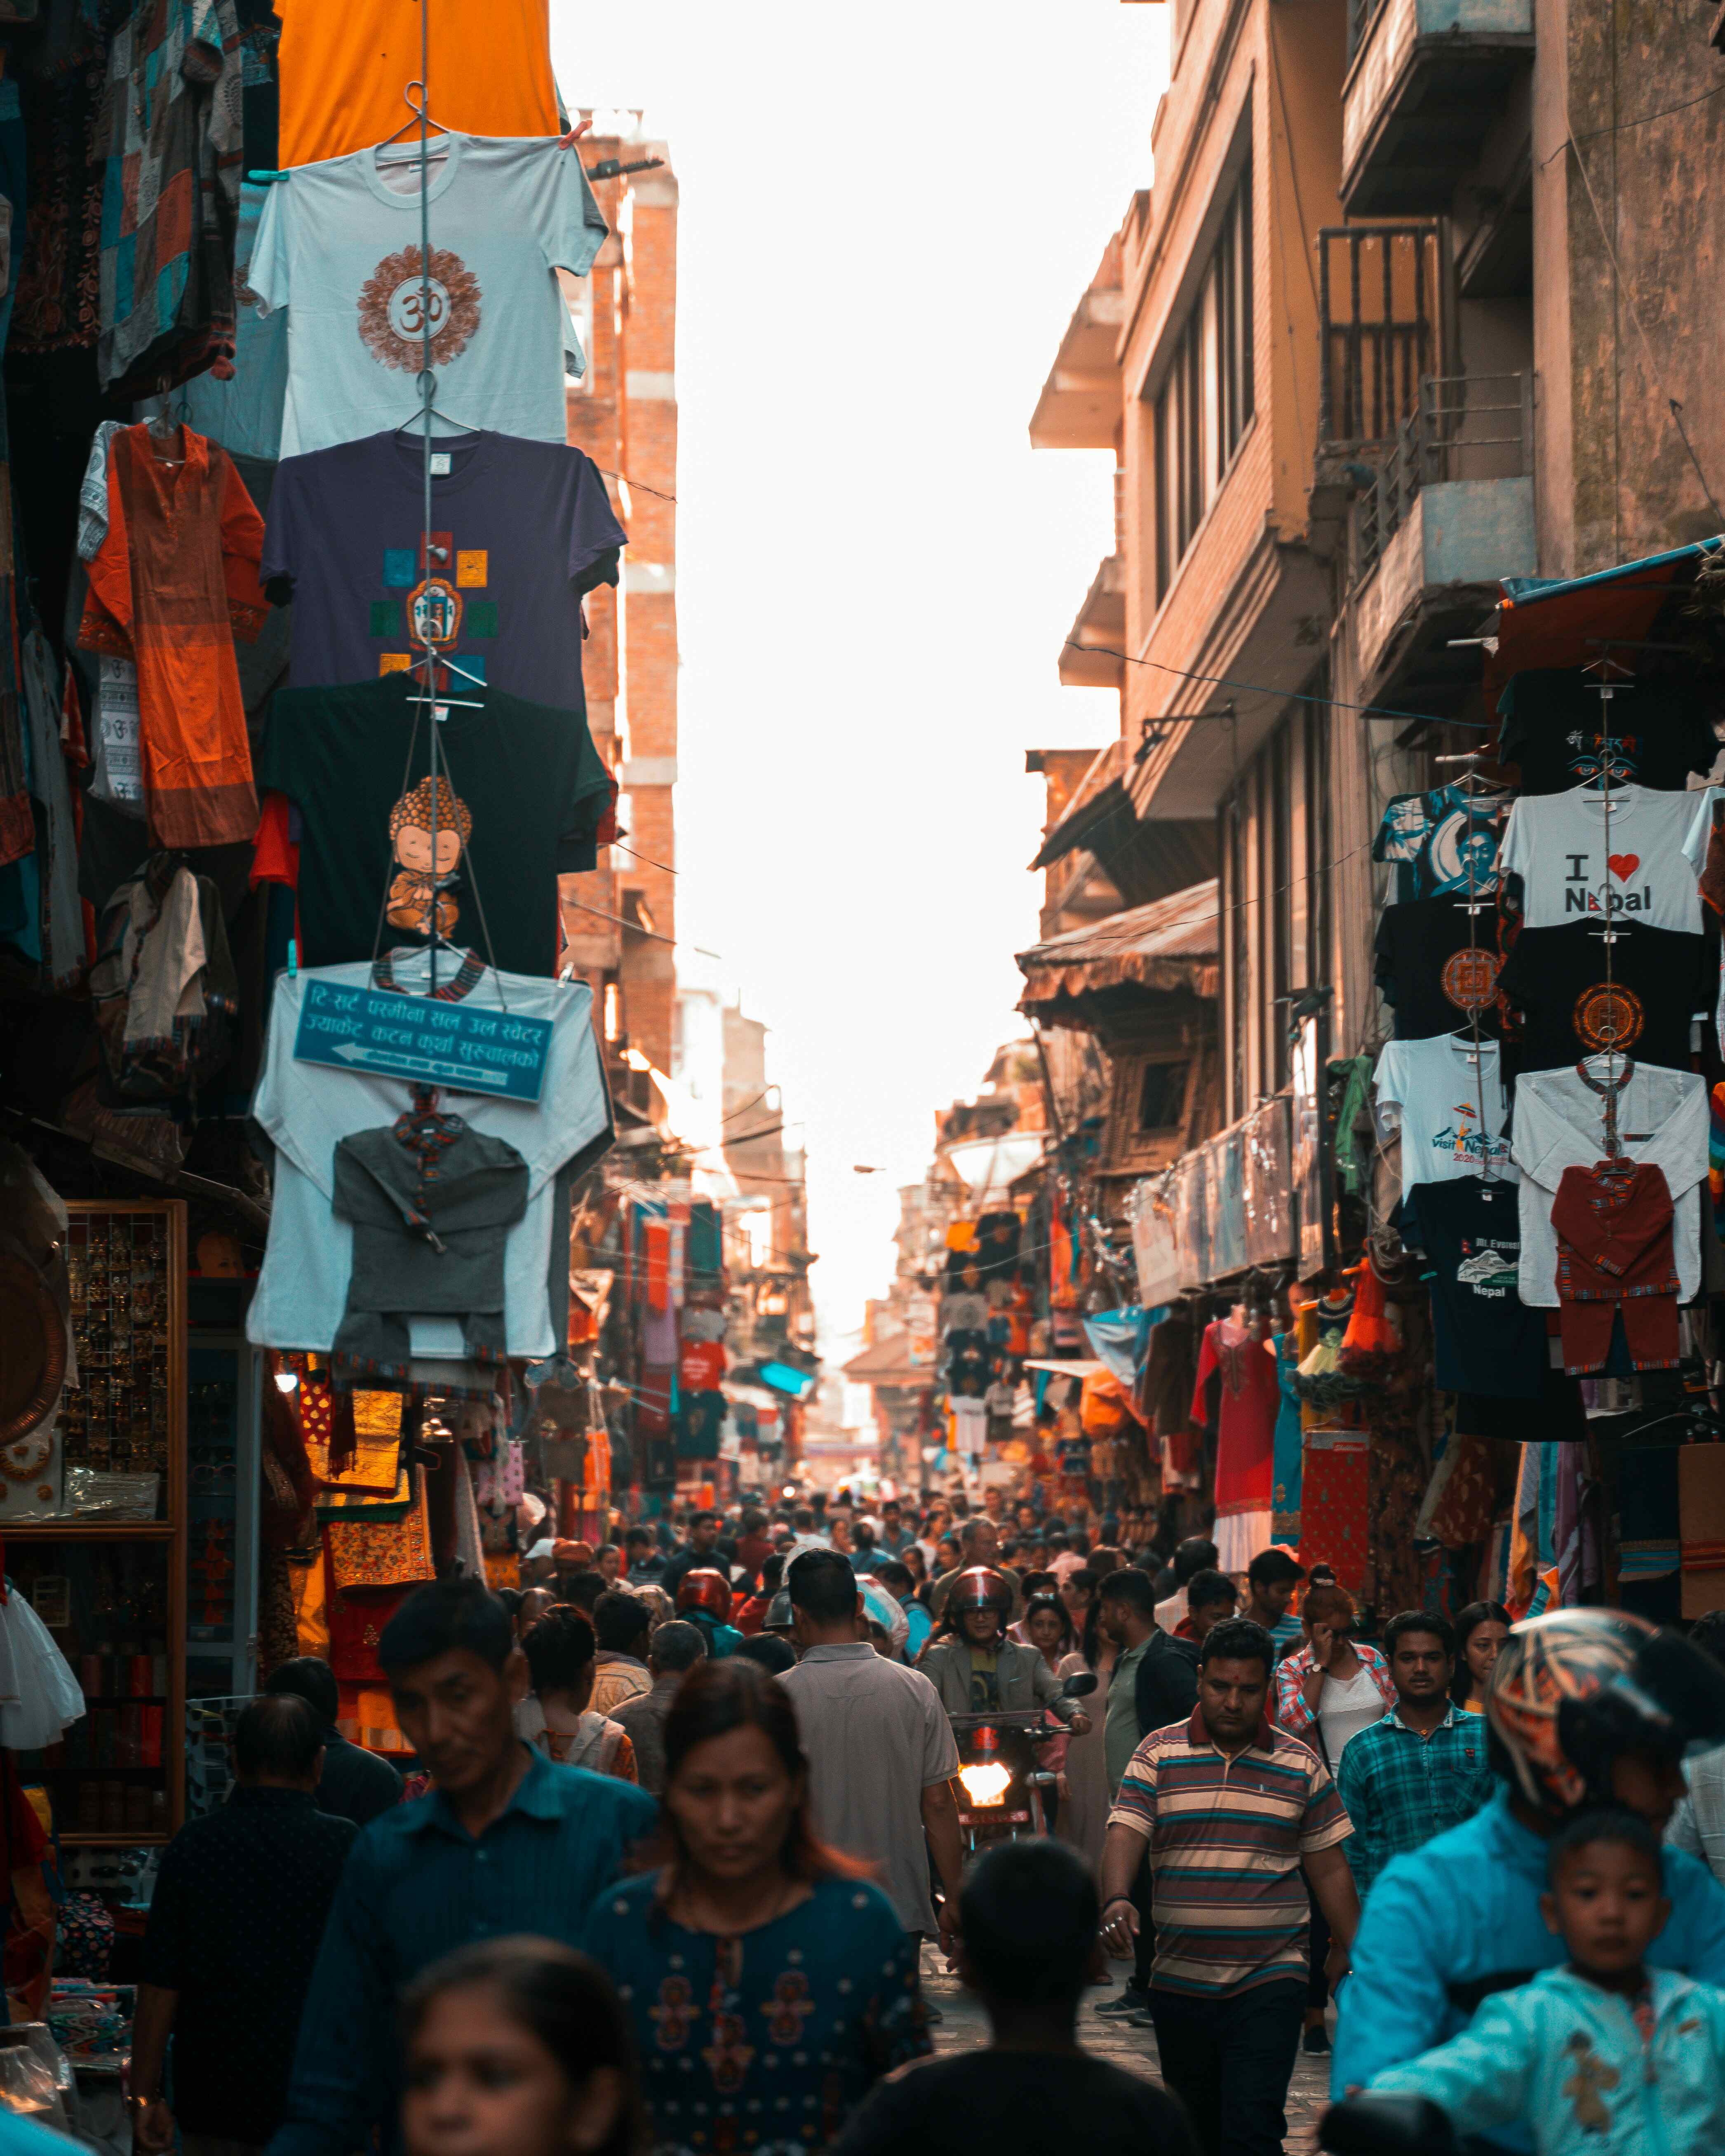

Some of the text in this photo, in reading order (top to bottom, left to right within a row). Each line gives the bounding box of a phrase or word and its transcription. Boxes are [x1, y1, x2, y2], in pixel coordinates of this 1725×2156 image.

[1565, 854, 1589, 881] I
[1565, 885, 1651, 918] Npal
[1431, 1138, 1502, 1158] visit Nepal
[1453, 1153, 1475, 1163] 2020
[1473, 1284, 1506, 1299] Nepal
